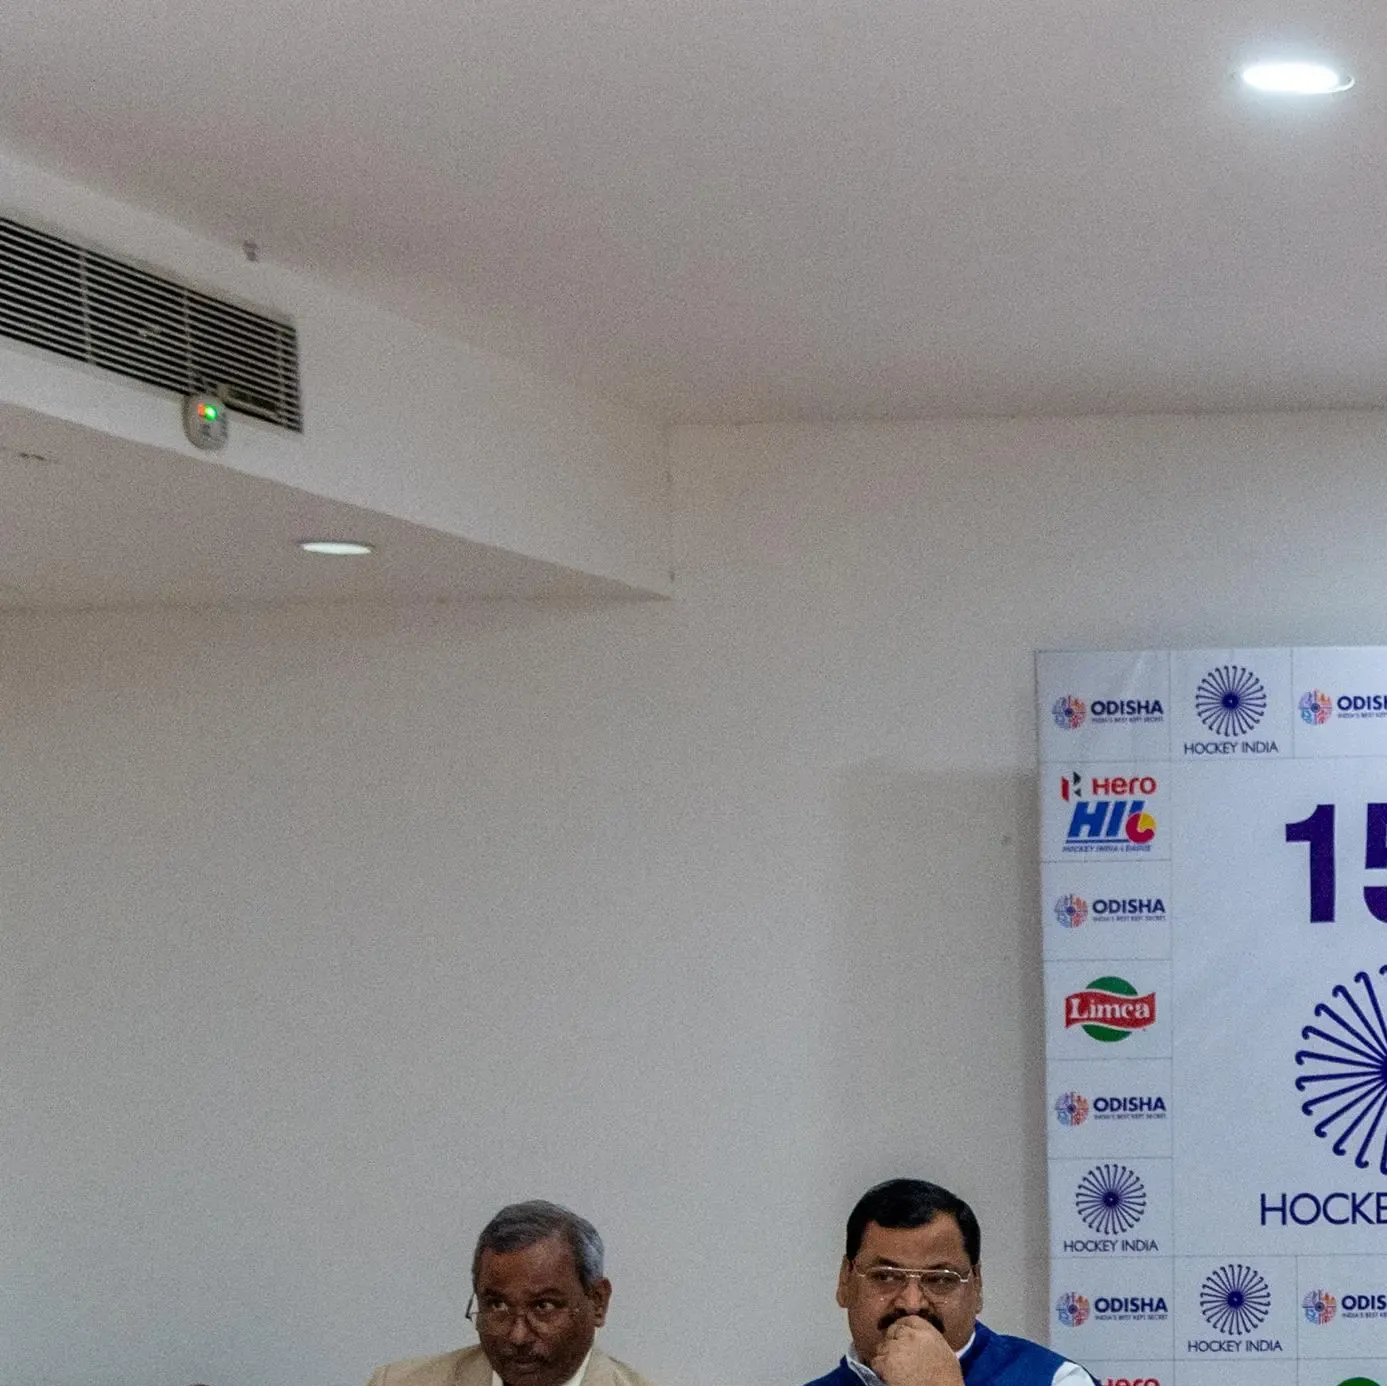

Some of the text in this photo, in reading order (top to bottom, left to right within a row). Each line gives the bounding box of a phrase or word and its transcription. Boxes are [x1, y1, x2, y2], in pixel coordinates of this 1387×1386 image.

[1091, 700, 1164, 716] ODISHA
[1184, 741, 1278, 754] HOCKEY INDIA
[1092, 777, 1156, 795] Hero
[1092, 899, 1166, 914] ODISHA
[1069, 998, 1150, 1021] Limca
[1093, 1097, 1166, 1112] ODISHA
[1064, 1239, 1158, 1252] HOCKEY INDIA
[1095, 1298, 1168, 1313] ODISHA
[1188, 1340, 1282, 1352] HOCKEY INDIA
